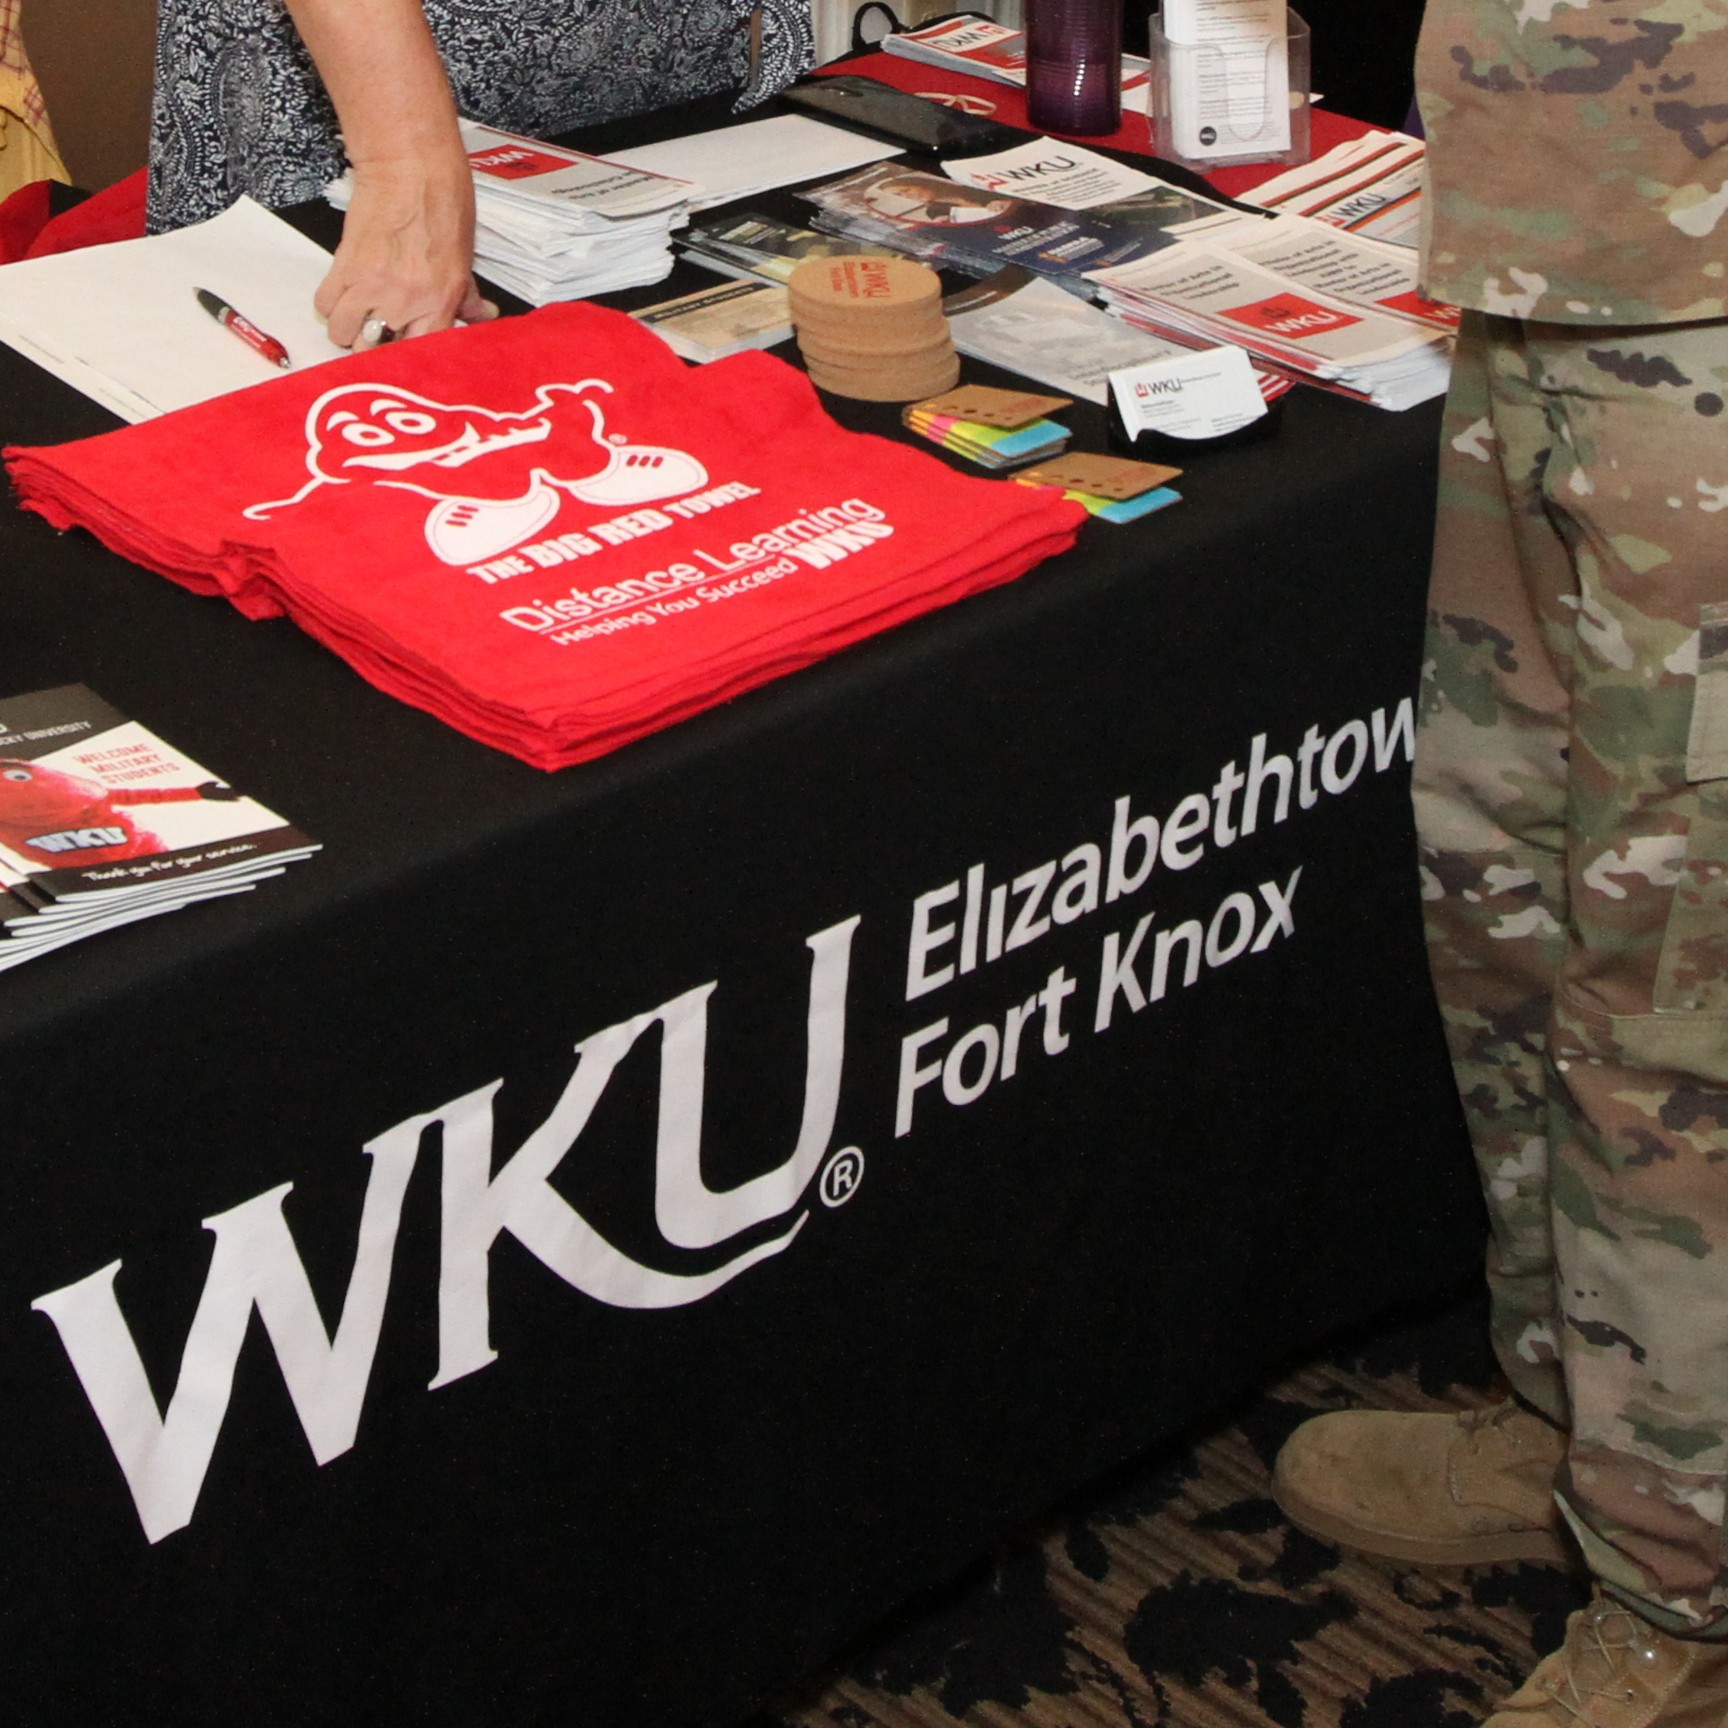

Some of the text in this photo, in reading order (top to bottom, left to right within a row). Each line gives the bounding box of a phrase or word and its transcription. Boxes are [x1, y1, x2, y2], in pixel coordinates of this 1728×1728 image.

[1001, 155, 1076, 181] WKU
[1333, 192, 1389, 218] WKU
[998, 225, 1035, 240] WKU
[1264, 309, 1331, 334] WKU
[1148, 378, 1183, 394] WKU
[466, 480, 761, 585] THE BIG RED TOWEL
[788, 518, 895, 571] WKU
[499, 497, 886, 633] Distance Learning
[550, 556, 798, 647] Helping You Succeed
[23, 720, 93, 741] UNIVERSITY
[75, 743, 153, 764] WELCOME
[89, 753, 162, 774] MILITARY
[103, 763, 181, 785] STUDENTS
[25, 826, 128, 854] WKU
[906, 696, 1416, 1002] Elizabethtow
[82, 869, 128, 882] Thank
[129, 865, 151, 878] you
[176, 854, 203, 868] your
[895, 865, 1304, 1139] Fort Knox
